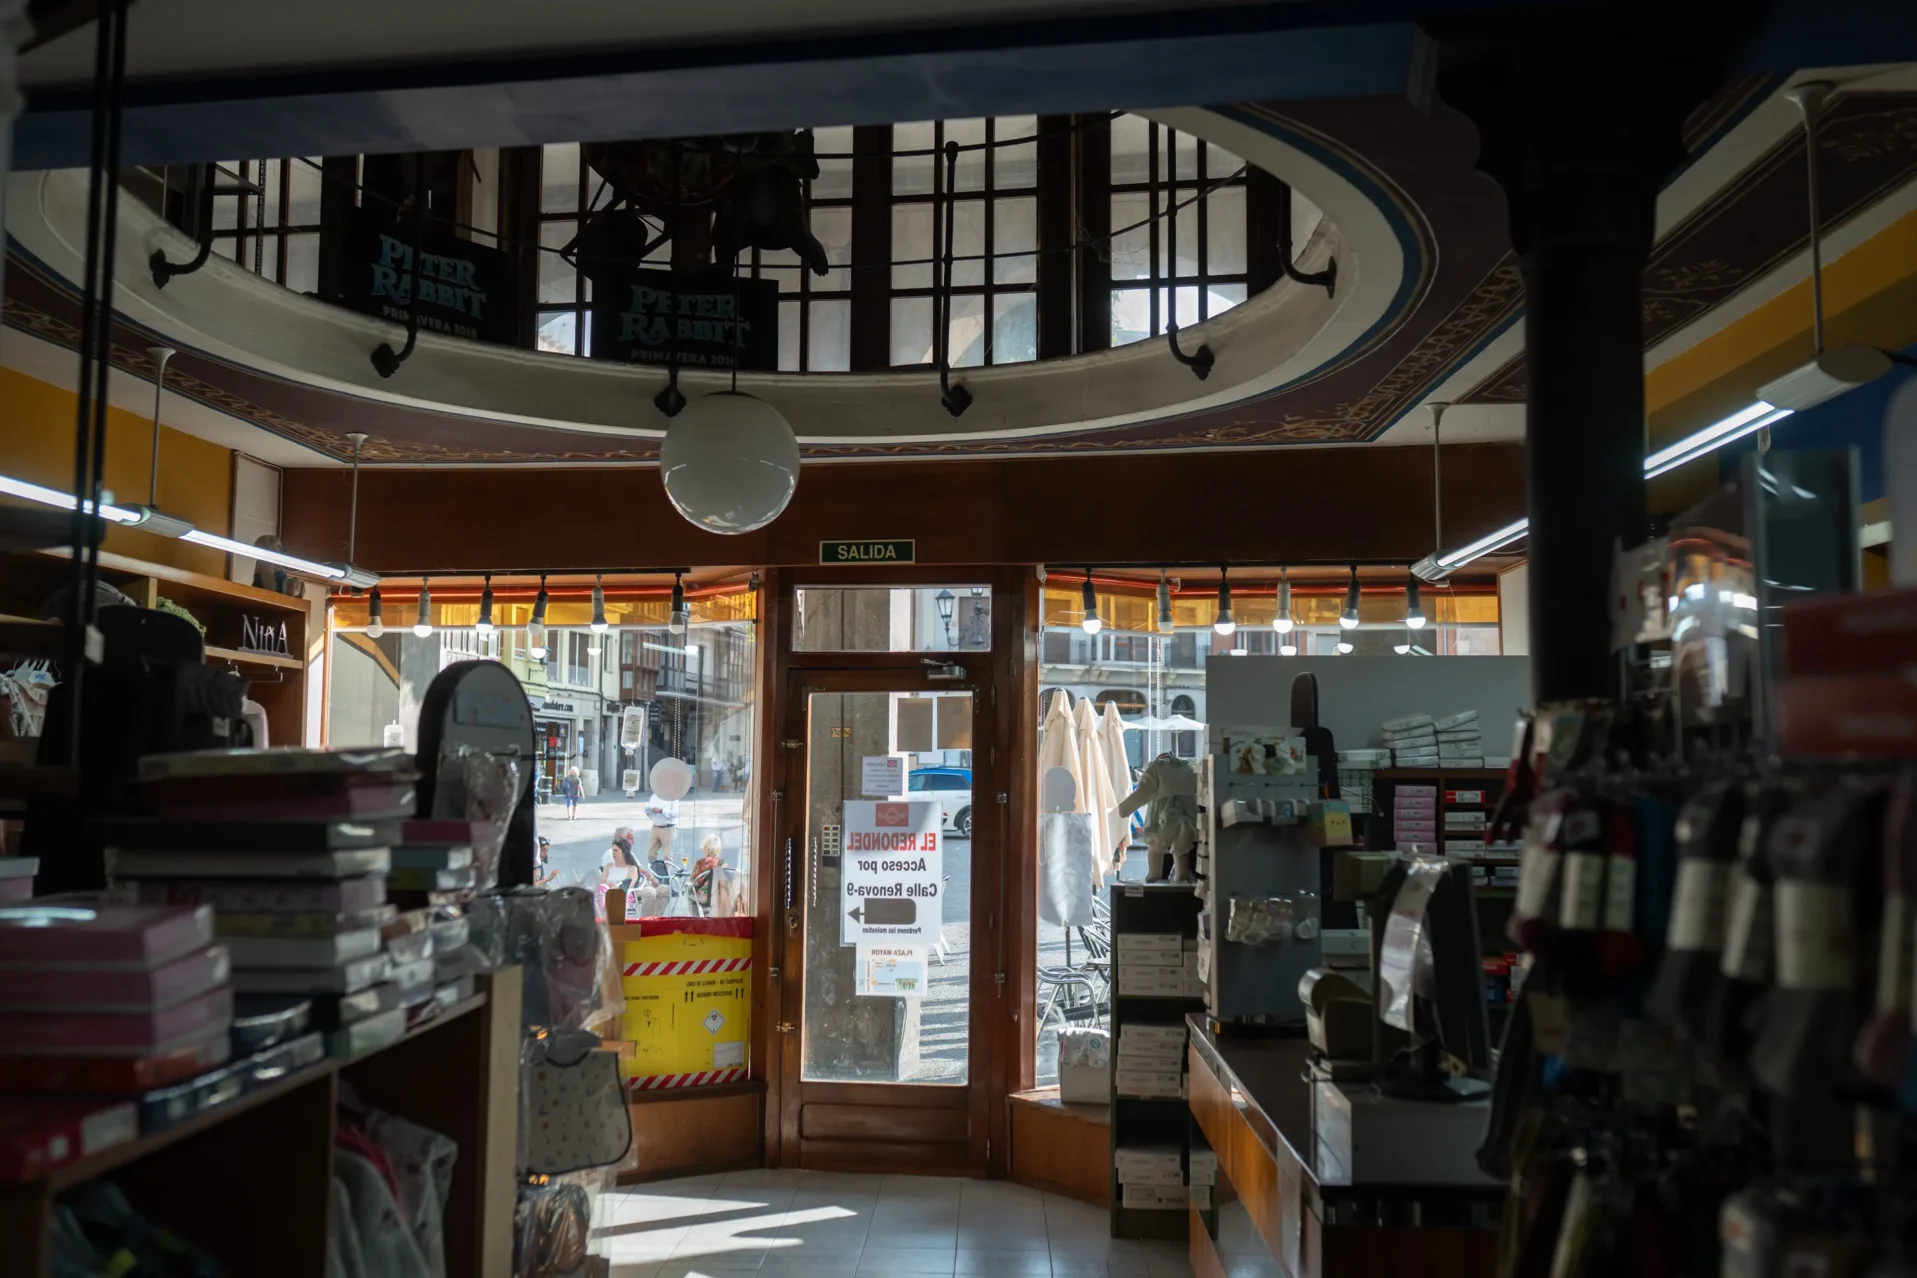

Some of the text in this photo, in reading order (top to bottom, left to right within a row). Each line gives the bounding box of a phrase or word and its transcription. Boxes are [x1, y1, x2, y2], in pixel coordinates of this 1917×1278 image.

[629, 282, 736, 319] PETER
[618, 312, 751, 349] RABBIT
[837, 544, 897, 560] SALIDA
